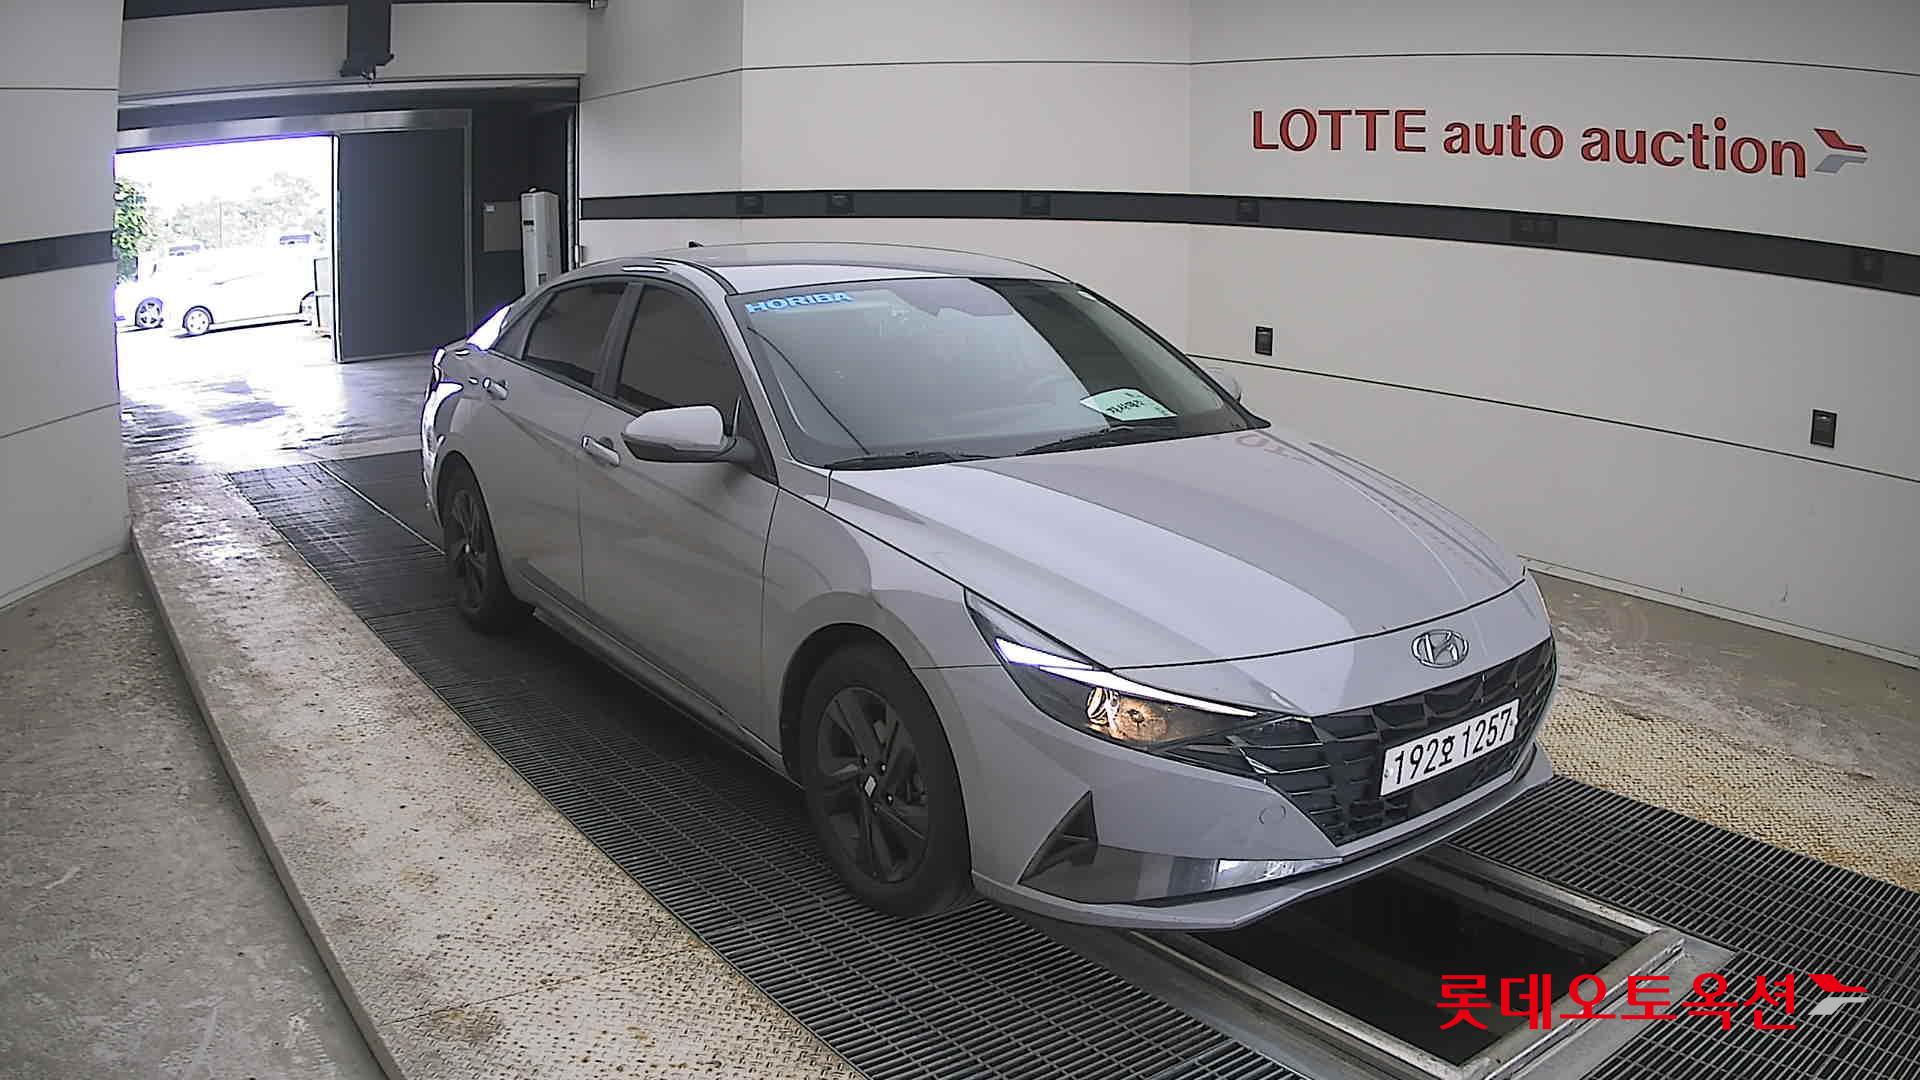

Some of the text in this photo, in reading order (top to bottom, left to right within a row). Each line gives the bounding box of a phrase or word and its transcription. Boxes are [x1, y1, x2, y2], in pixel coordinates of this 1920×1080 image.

[1252, 108, 1807, 179] LOTTE auto auction
[745, 291, 854, 313] HORIBA
[1394, 707, 1513, 785] 192호 1257
